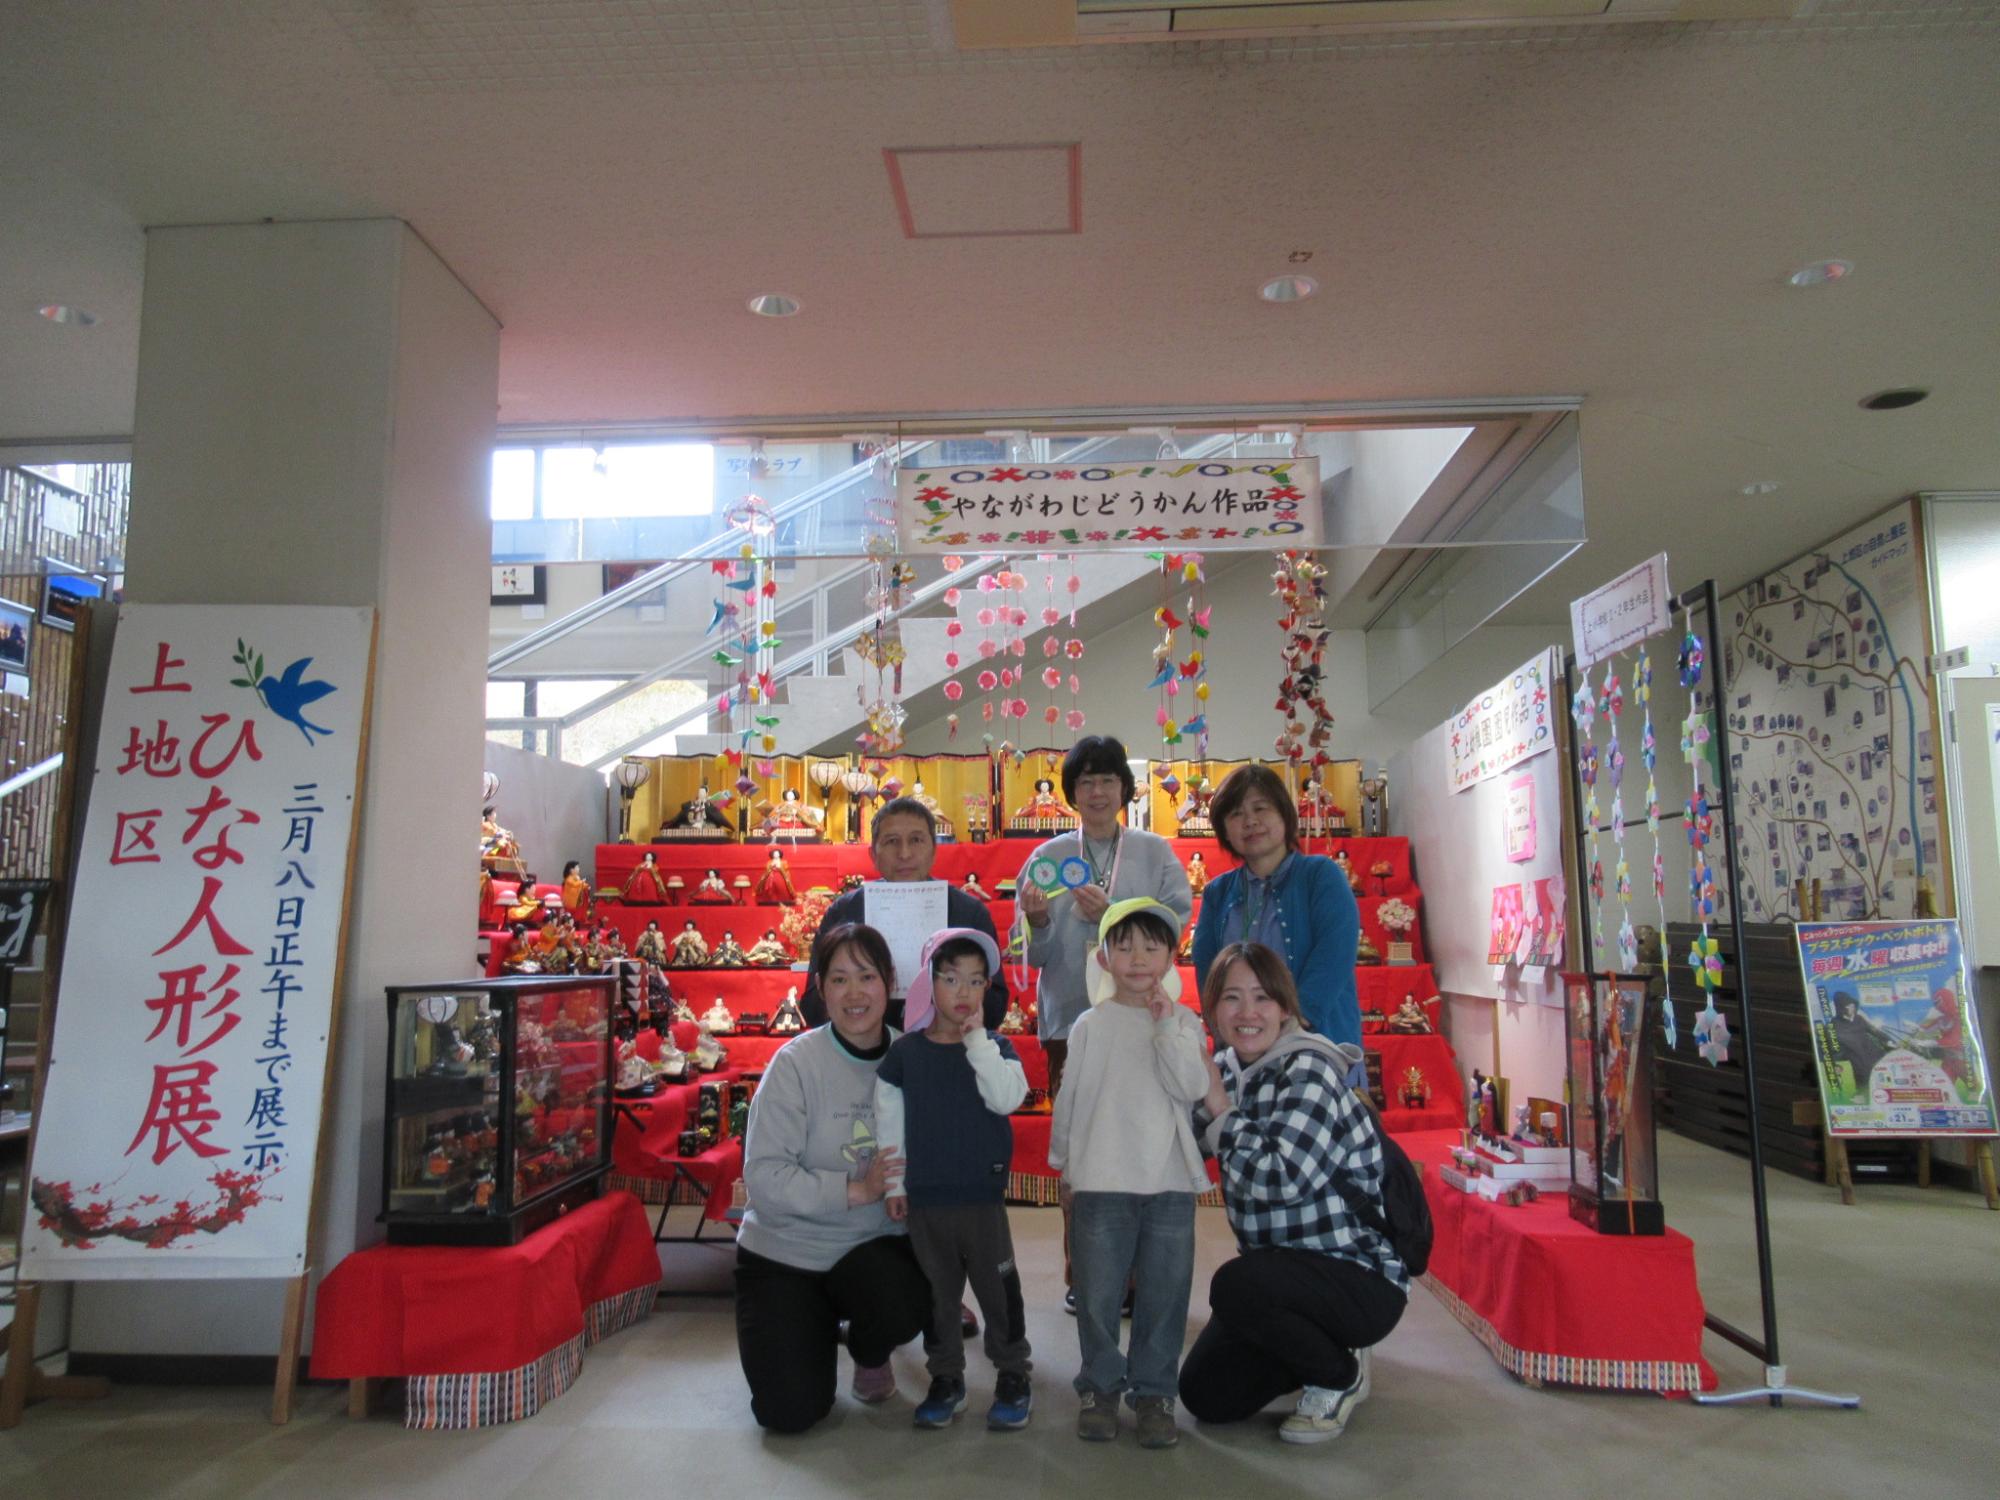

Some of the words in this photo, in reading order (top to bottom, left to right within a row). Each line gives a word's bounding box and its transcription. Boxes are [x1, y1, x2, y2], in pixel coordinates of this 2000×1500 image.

[952, 488, 1268, 521] やながわじどうかん作品
[109, 642, 192, 866] 上地区
[124, 713, 263, 1166] ひな人形展
[243, 783, 324, 1171] 三月八日正午まで展示
